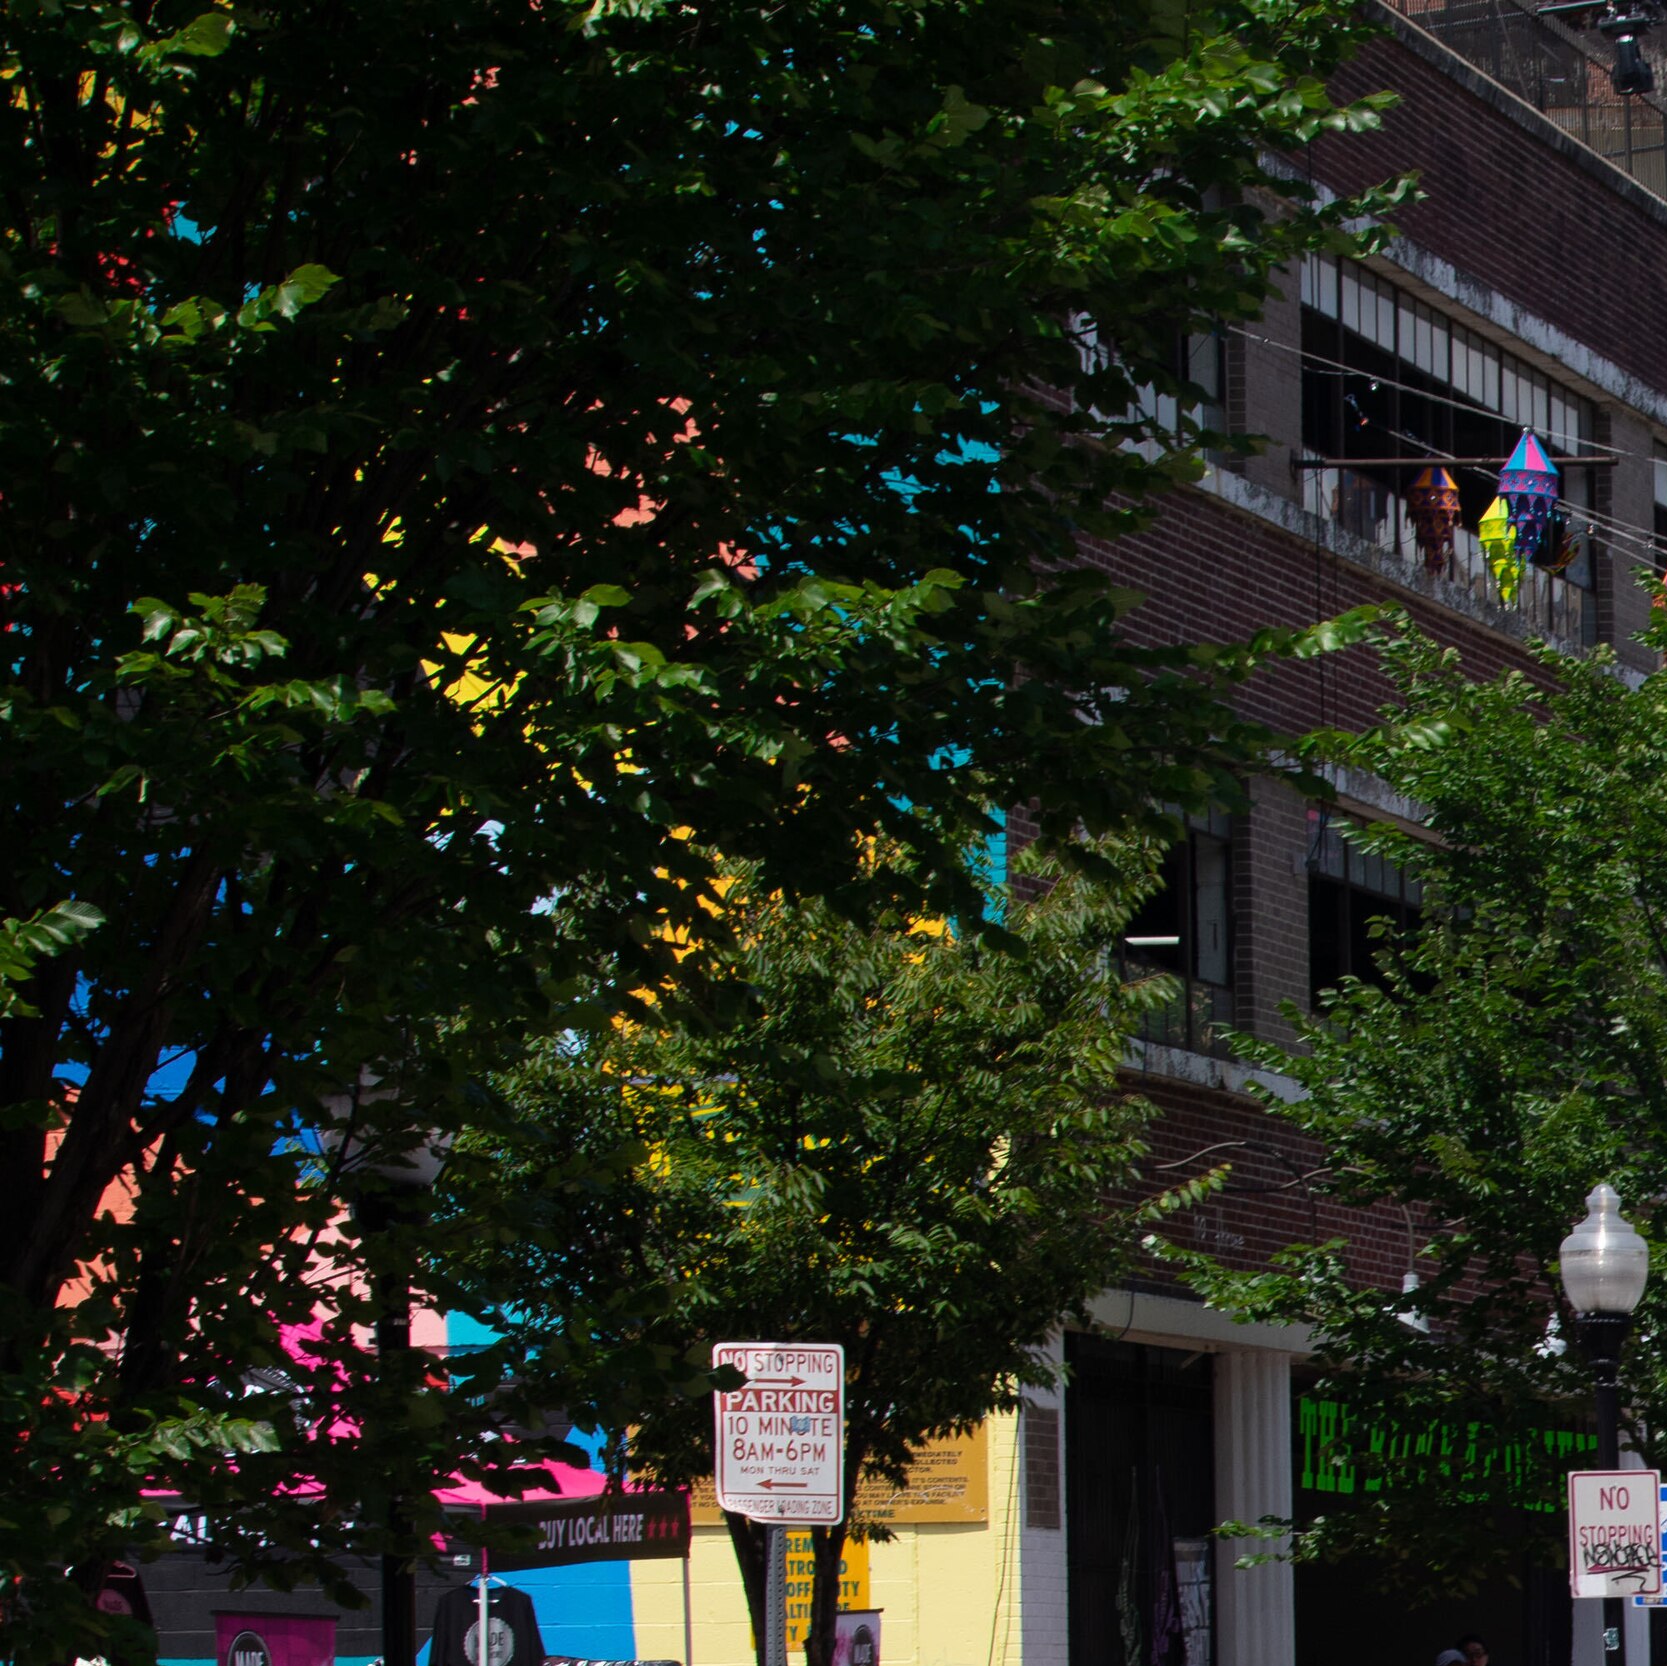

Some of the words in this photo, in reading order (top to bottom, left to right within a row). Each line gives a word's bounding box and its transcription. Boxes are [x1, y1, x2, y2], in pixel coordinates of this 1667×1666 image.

[721, 1349, 747, 1373] NO
[755, 1352, 834, 1374] STOPPING
[726, 1391, 835, 1413] PARKING
[729, 1416, 748, 1435] 10
[759, 1416, 832, 1436] MINTE
[733, 1438, 826, 1462] 8AM-6PM
[741, 1466, 765, 1475] MON
[769, 1466, 796, 1475] THRU
[800, 1466, 820, 1475] SAT
[1600, 1486, 1630, 1511] NO
[568, 1514, 610, 1546] LOCAL
[613, 1513, 644, 1542] HERE
[1580, 1525, 1653, 1548] STOPPING
